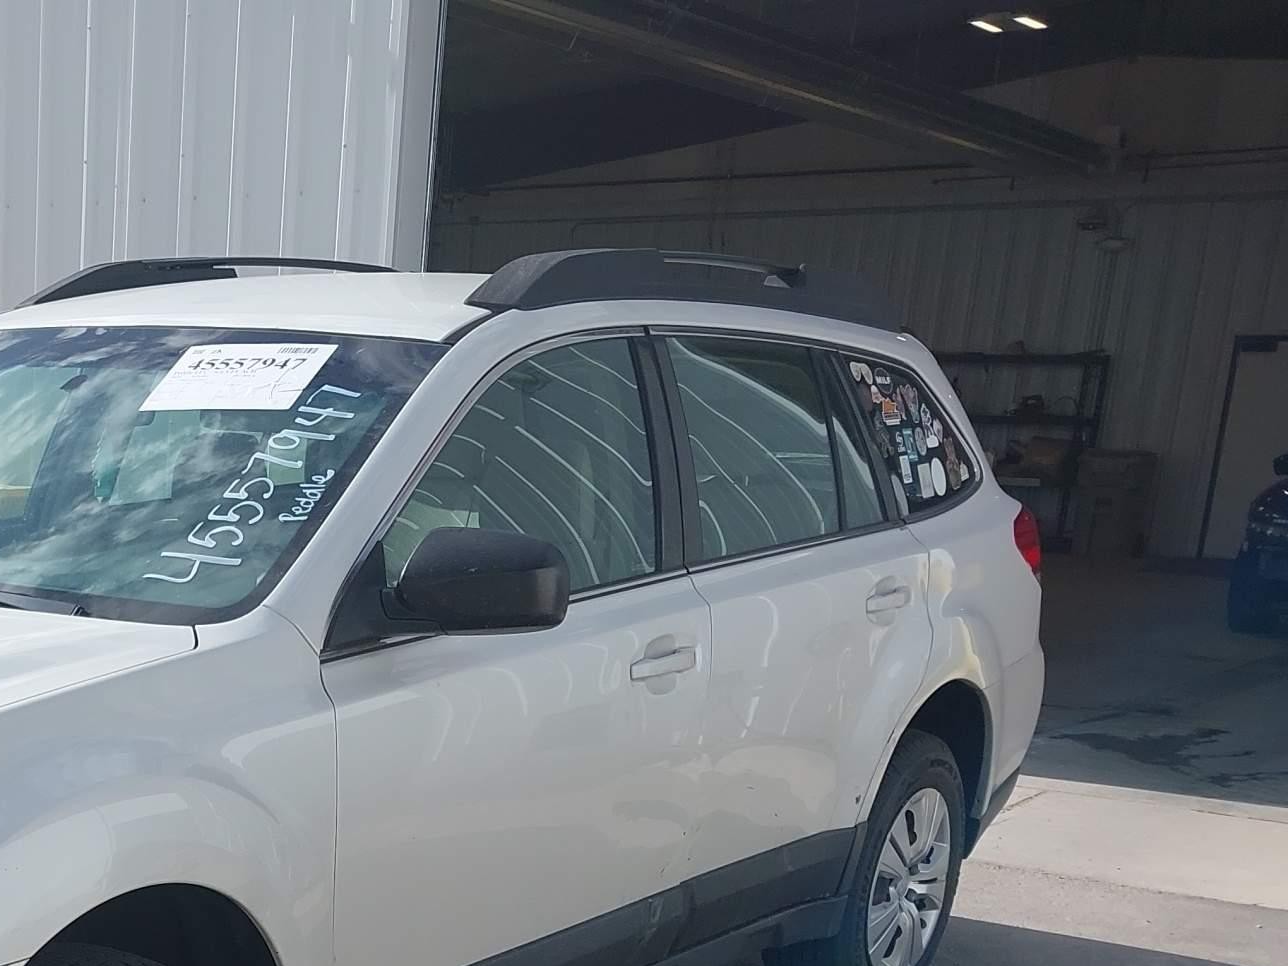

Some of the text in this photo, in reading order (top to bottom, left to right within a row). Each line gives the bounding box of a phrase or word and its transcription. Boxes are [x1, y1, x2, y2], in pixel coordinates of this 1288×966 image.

[188, 358, 307, 370] 45557947
[142, 384, 361, 583] 45557947
[278, 468, 336, 522] Peddle
